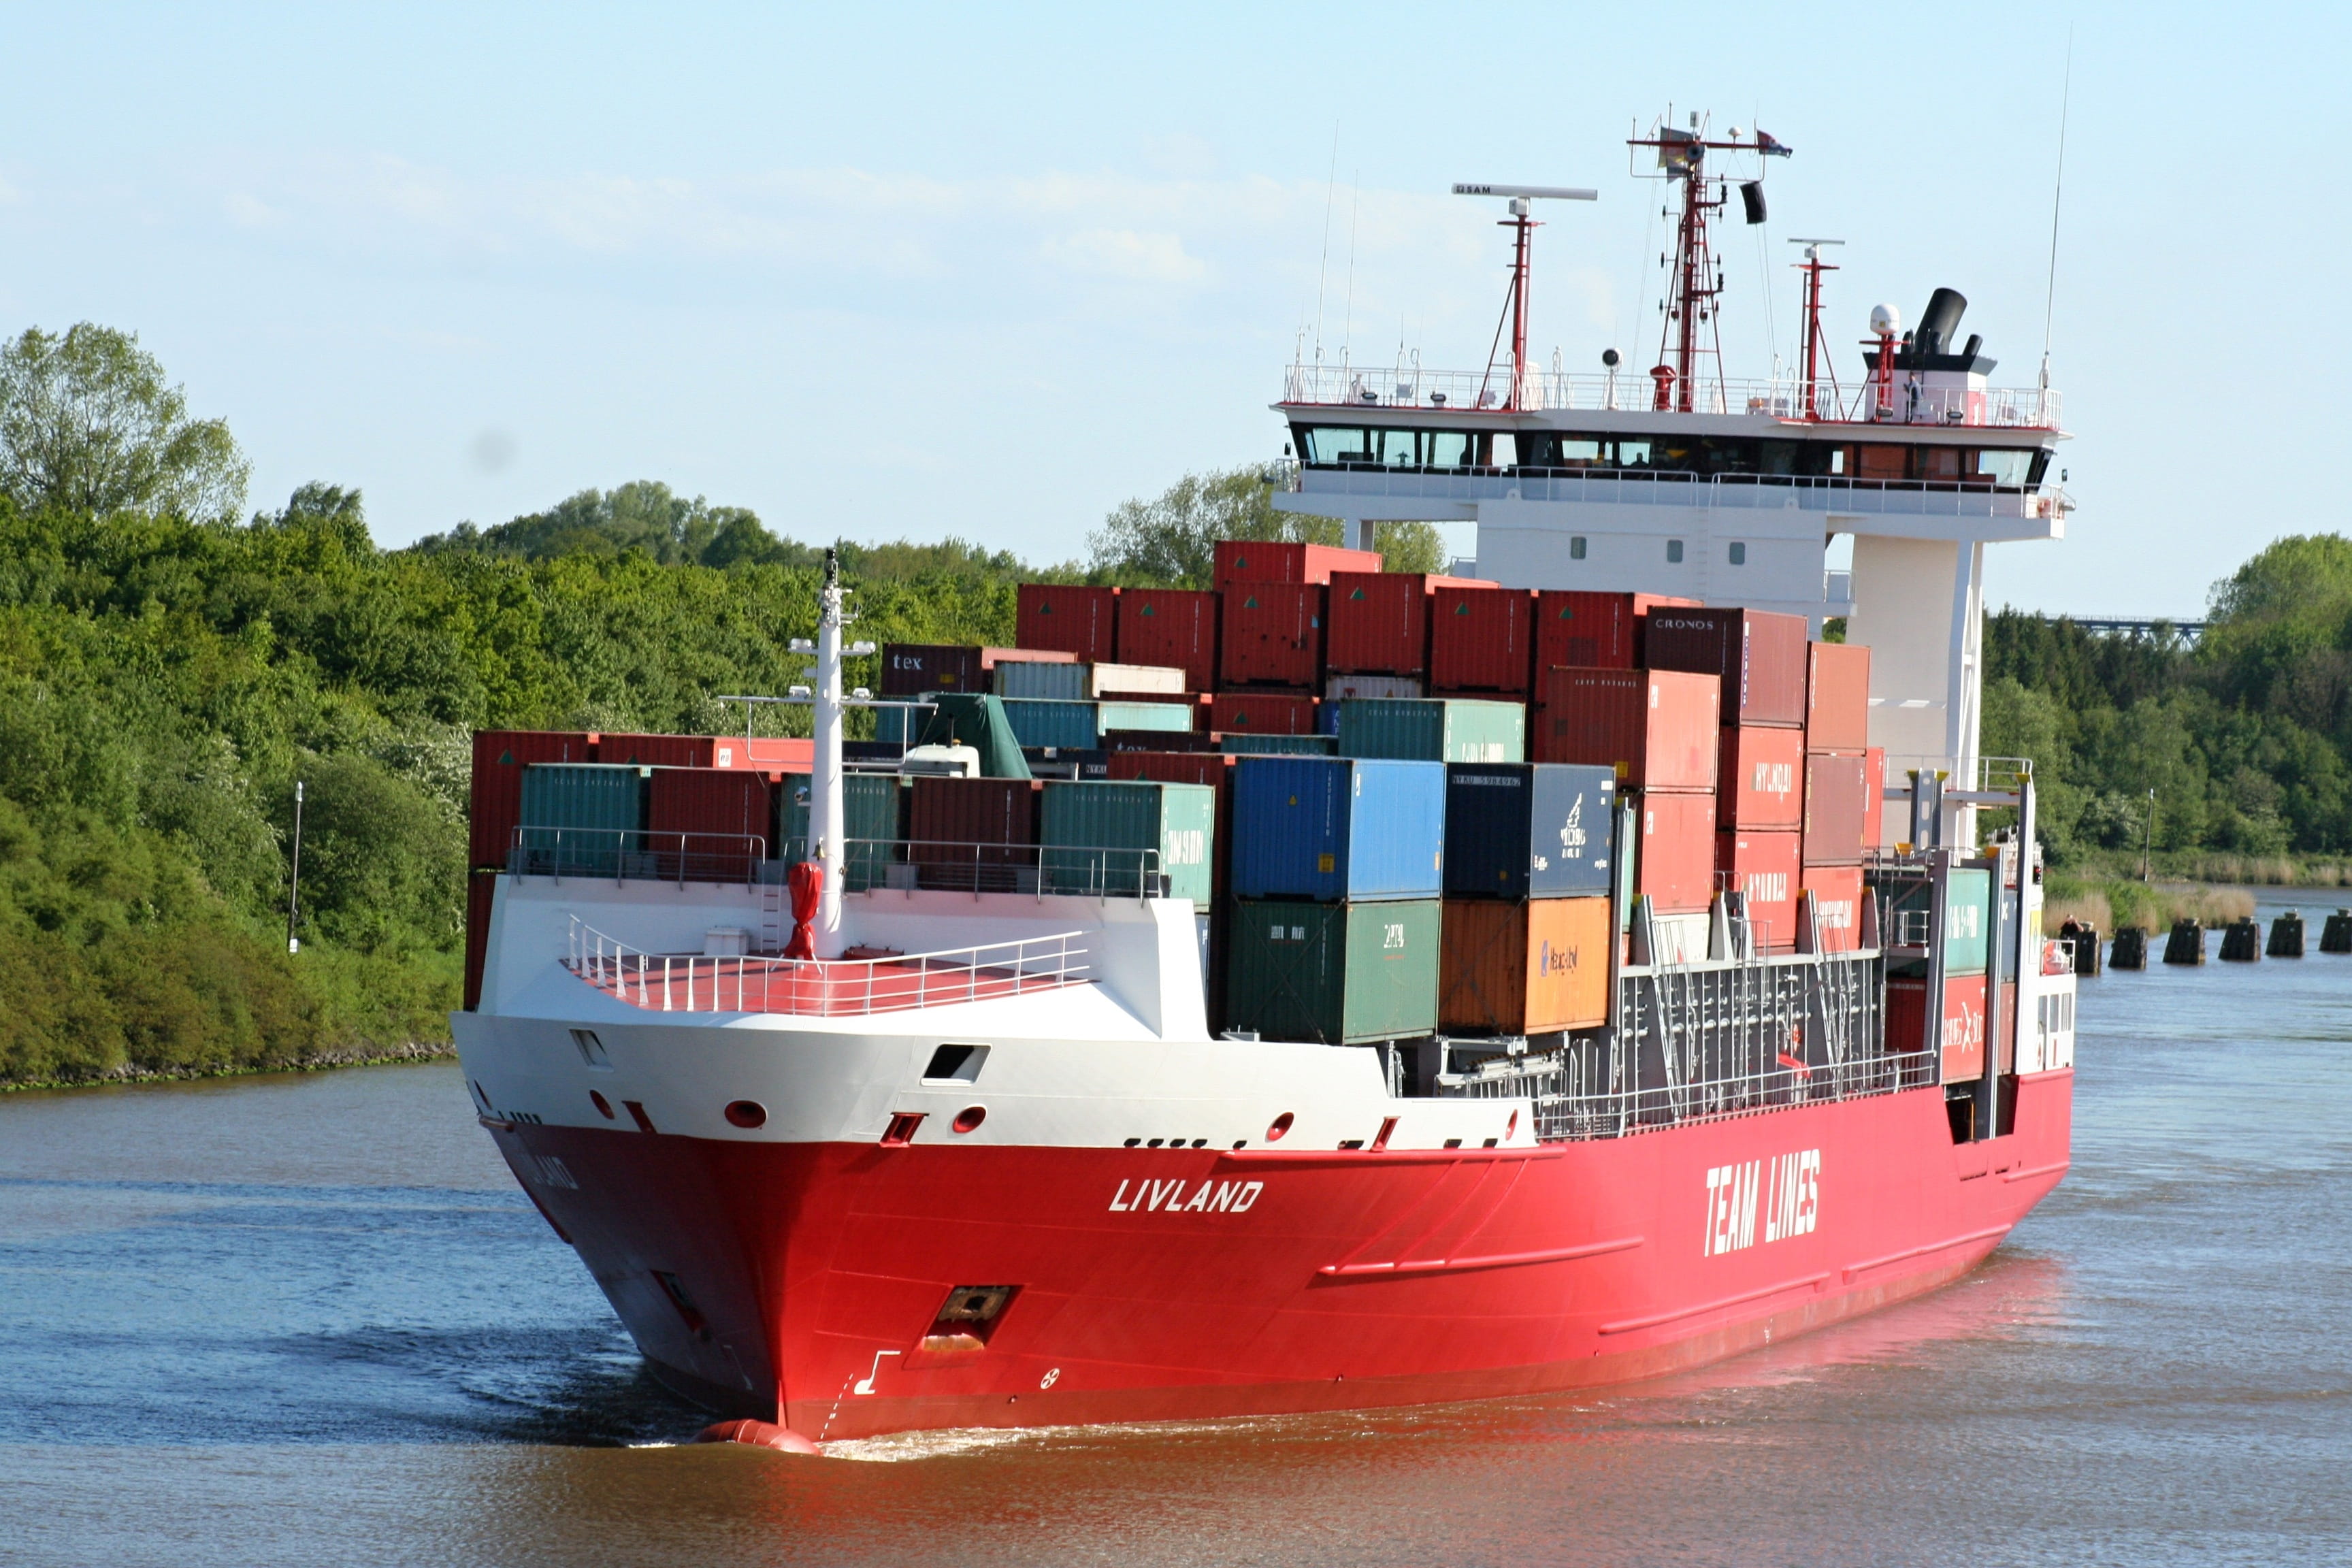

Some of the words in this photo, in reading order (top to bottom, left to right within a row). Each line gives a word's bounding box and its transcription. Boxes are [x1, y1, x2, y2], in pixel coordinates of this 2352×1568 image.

[1655, 619, 1714, 630] CRONOS
[894, 654, 923, 670] tex
[1756, 762, 1791, 792] HYUNDAI
[1108, 1179, 1264, 1213] LIVLAND
[1704, 1159, 1761, 1258] TEAM
[1765, 1148, 1820, 1243] LINES
